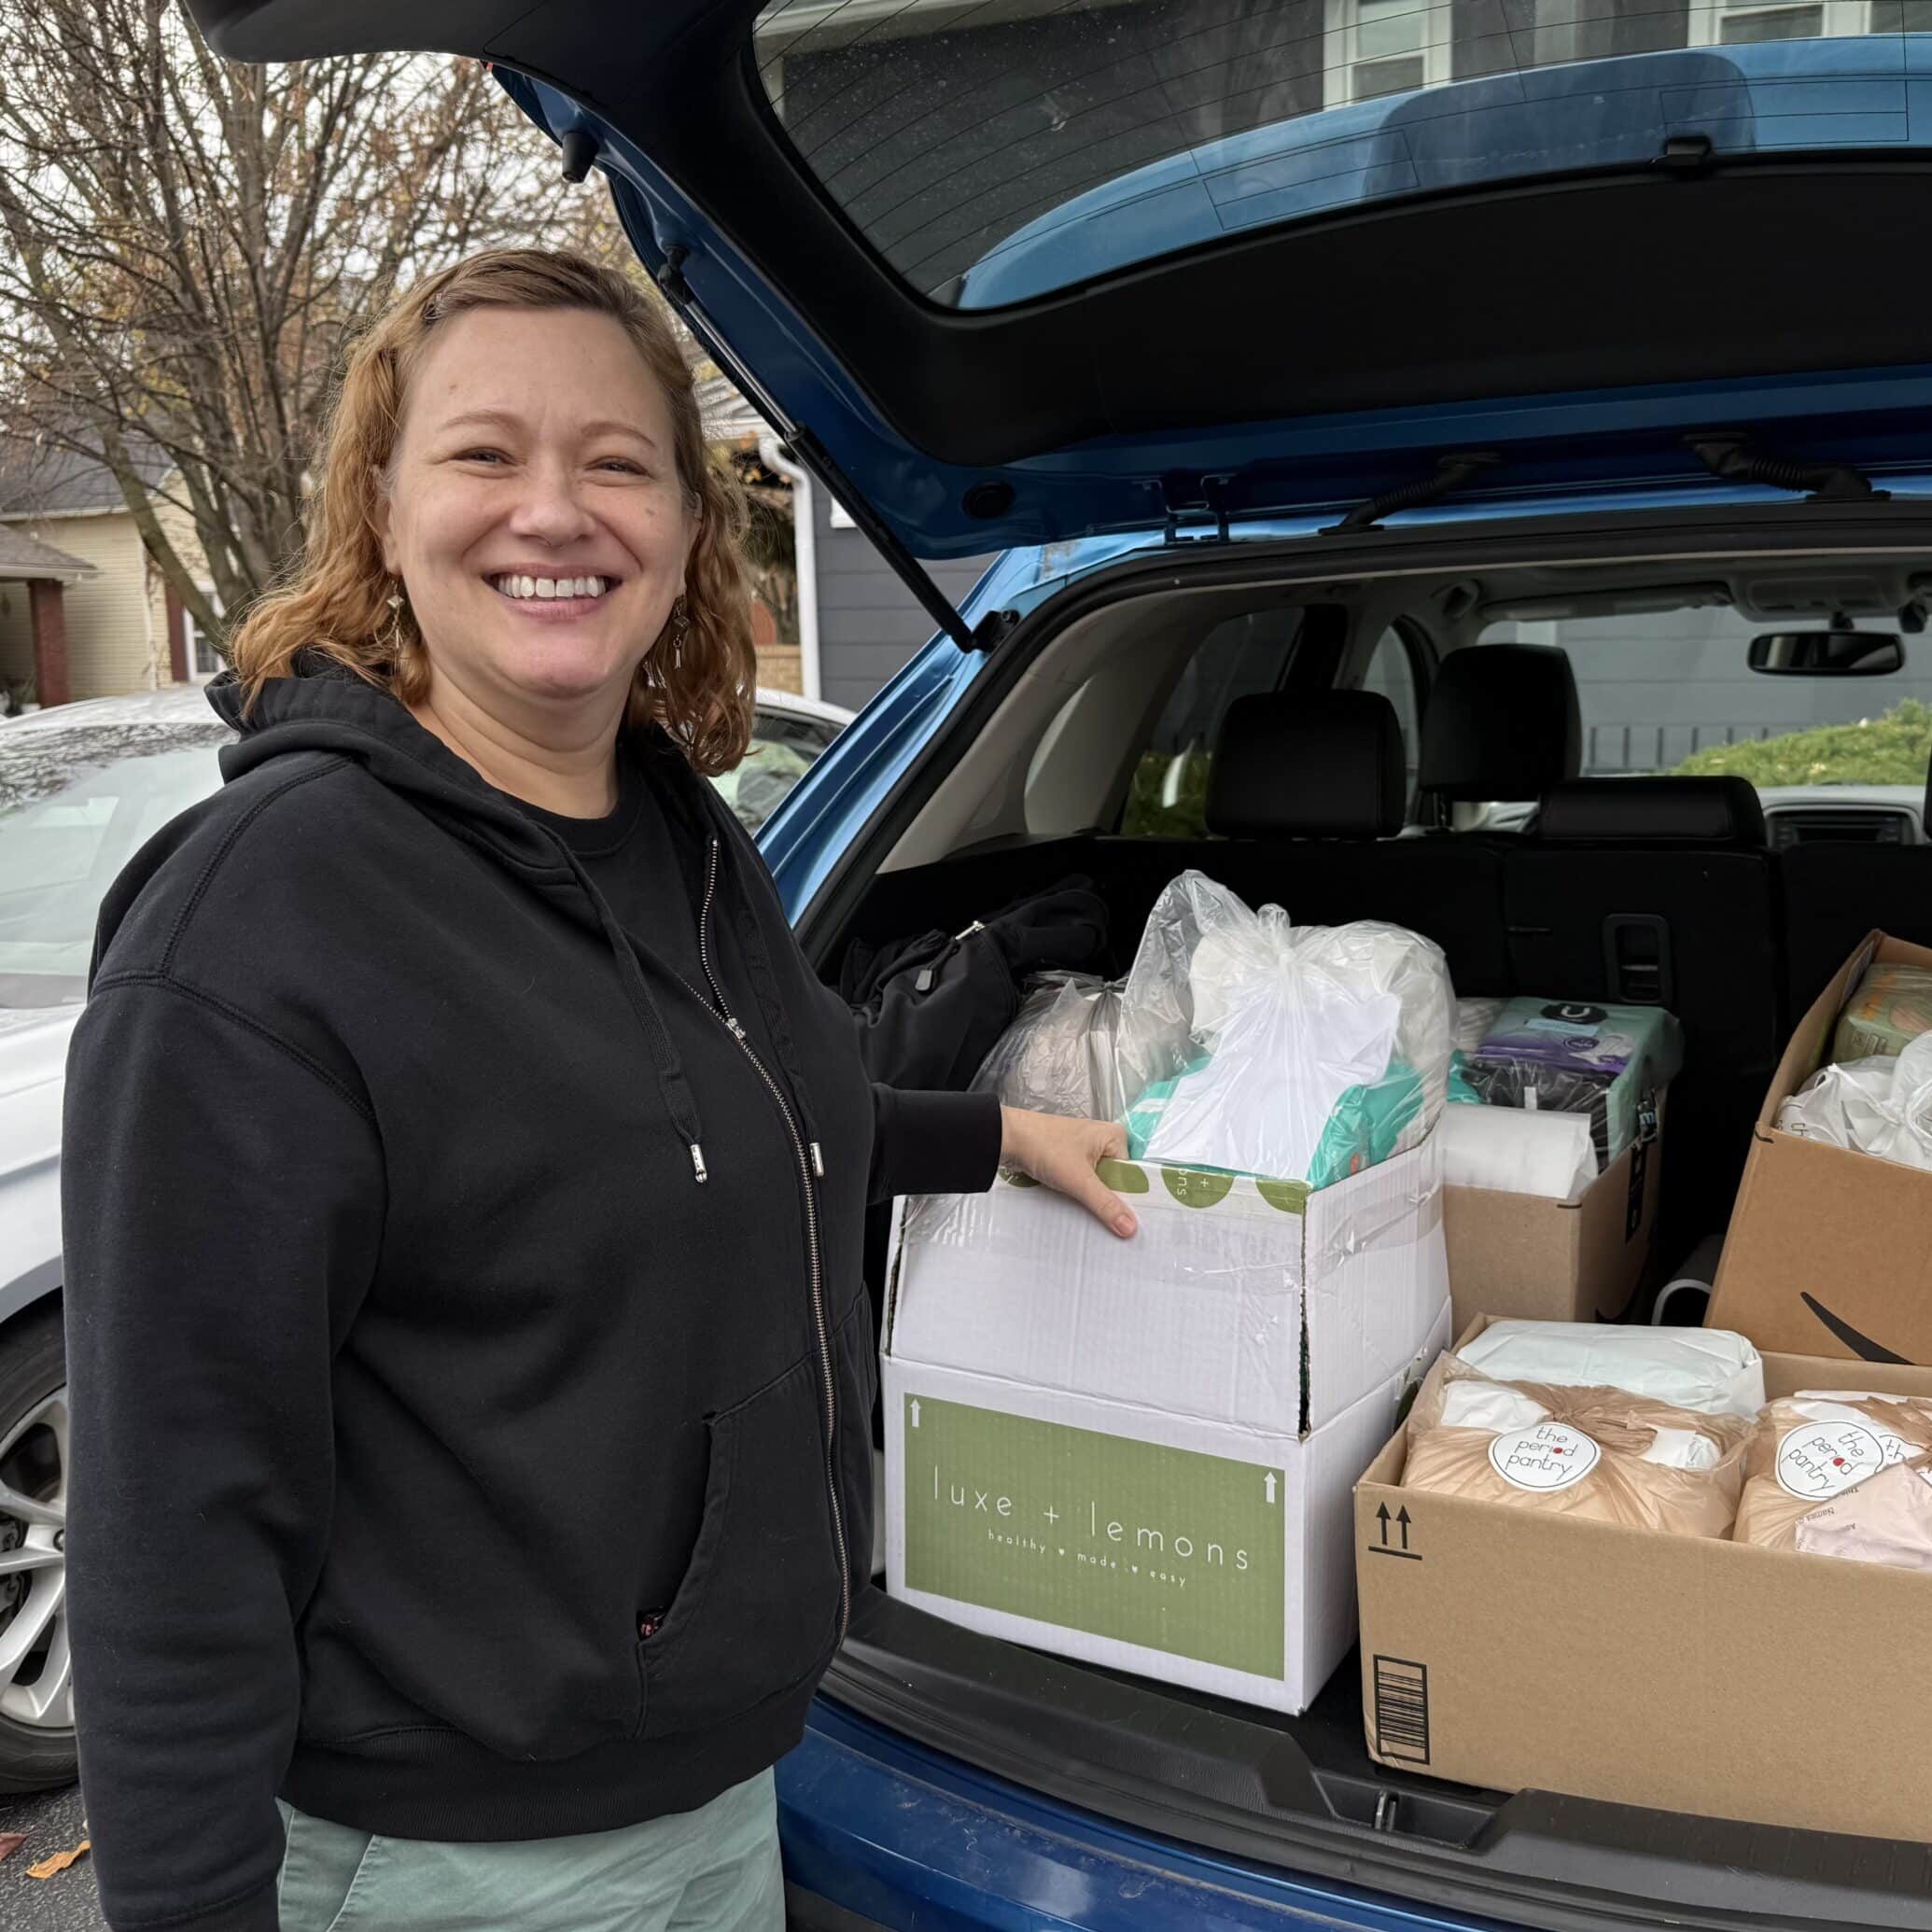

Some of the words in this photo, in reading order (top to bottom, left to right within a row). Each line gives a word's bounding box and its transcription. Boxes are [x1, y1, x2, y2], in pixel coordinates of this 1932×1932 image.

[1535, 1425, 1569, 1443] the
[1837, 1431, 1866, 1458] the
[1505, 1453, 1574, 1482] pantry
[1780, 1448, 1837, 1492] pantry
[933, 1464, 1013, 1517] luxe
[1090, 1500, 1250, 1571] lemons
[987, 1527, 1046, 1554] healthy
[1076, 1552, 1117, 1570] made
[1149, 1569, 1187, 1588] easy
